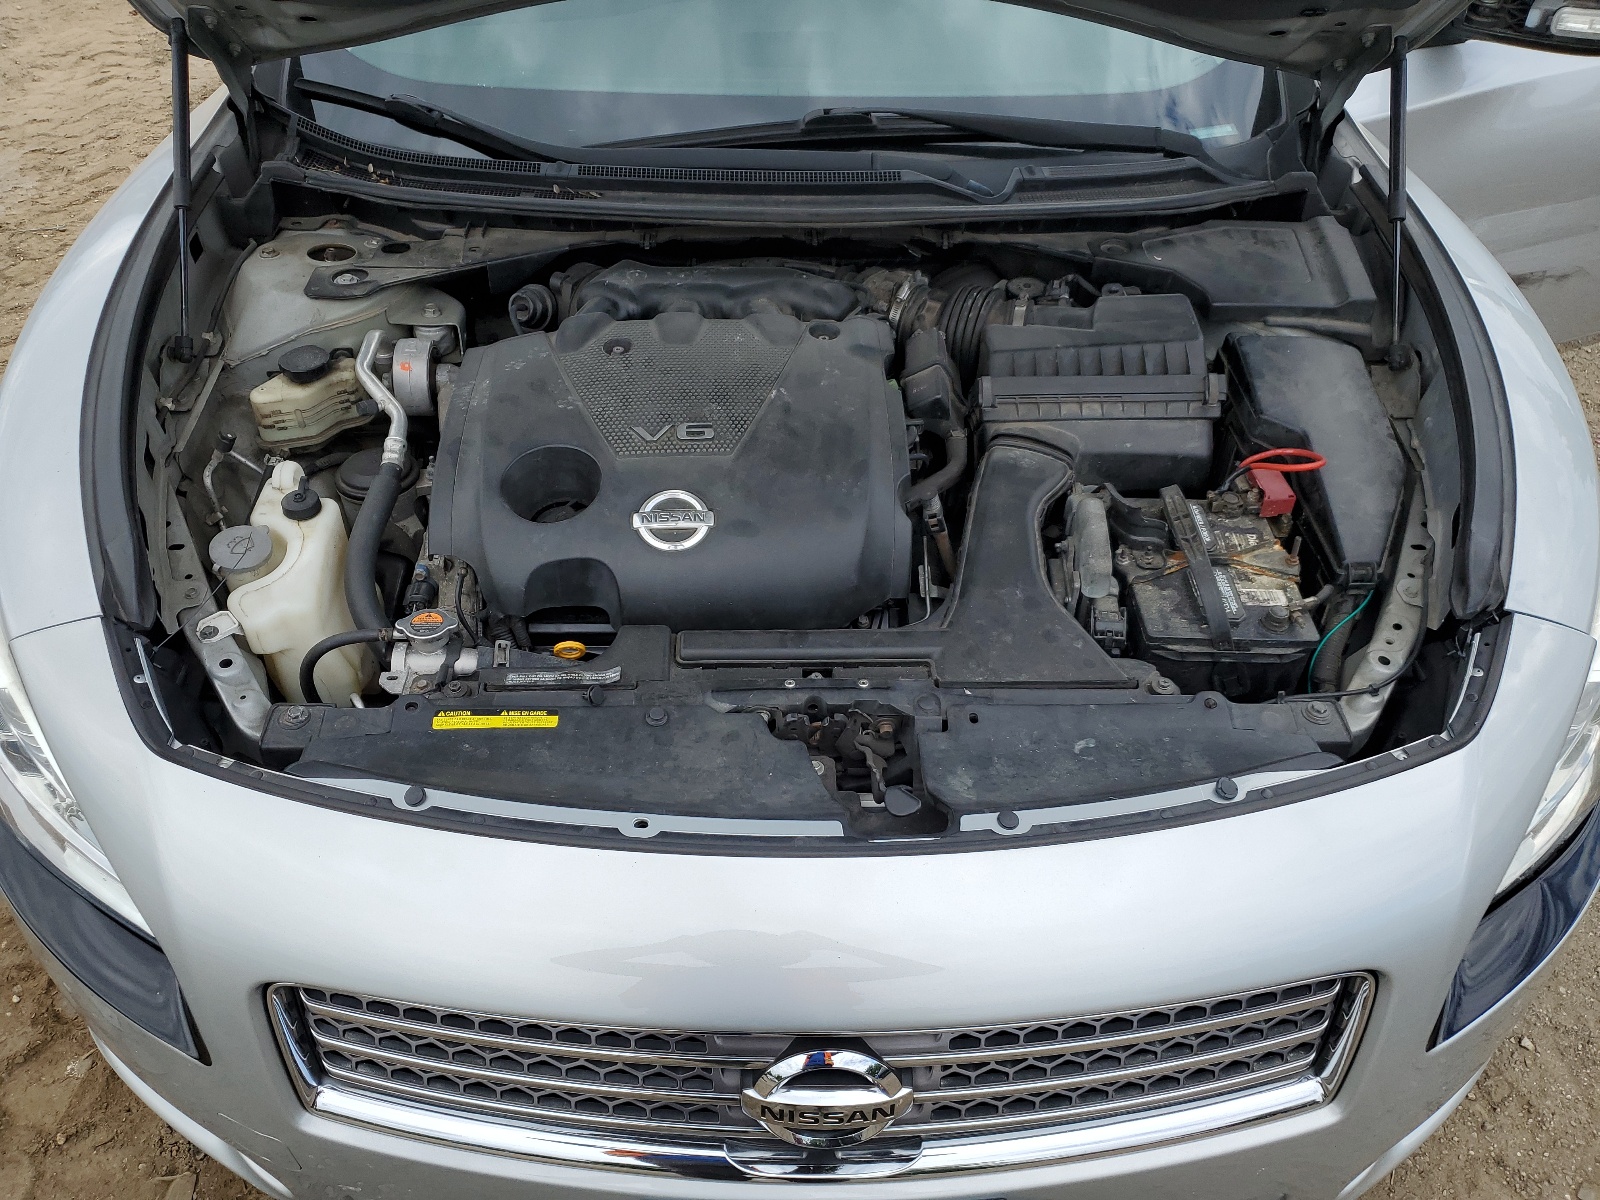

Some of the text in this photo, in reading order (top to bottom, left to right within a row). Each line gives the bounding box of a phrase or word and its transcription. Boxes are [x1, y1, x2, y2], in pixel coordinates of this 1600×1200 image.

[630, 422, 715, 441] V6
[641, 511, 706, 524] NISSAN
[760, 1103, 896, 1126] NISSAN
